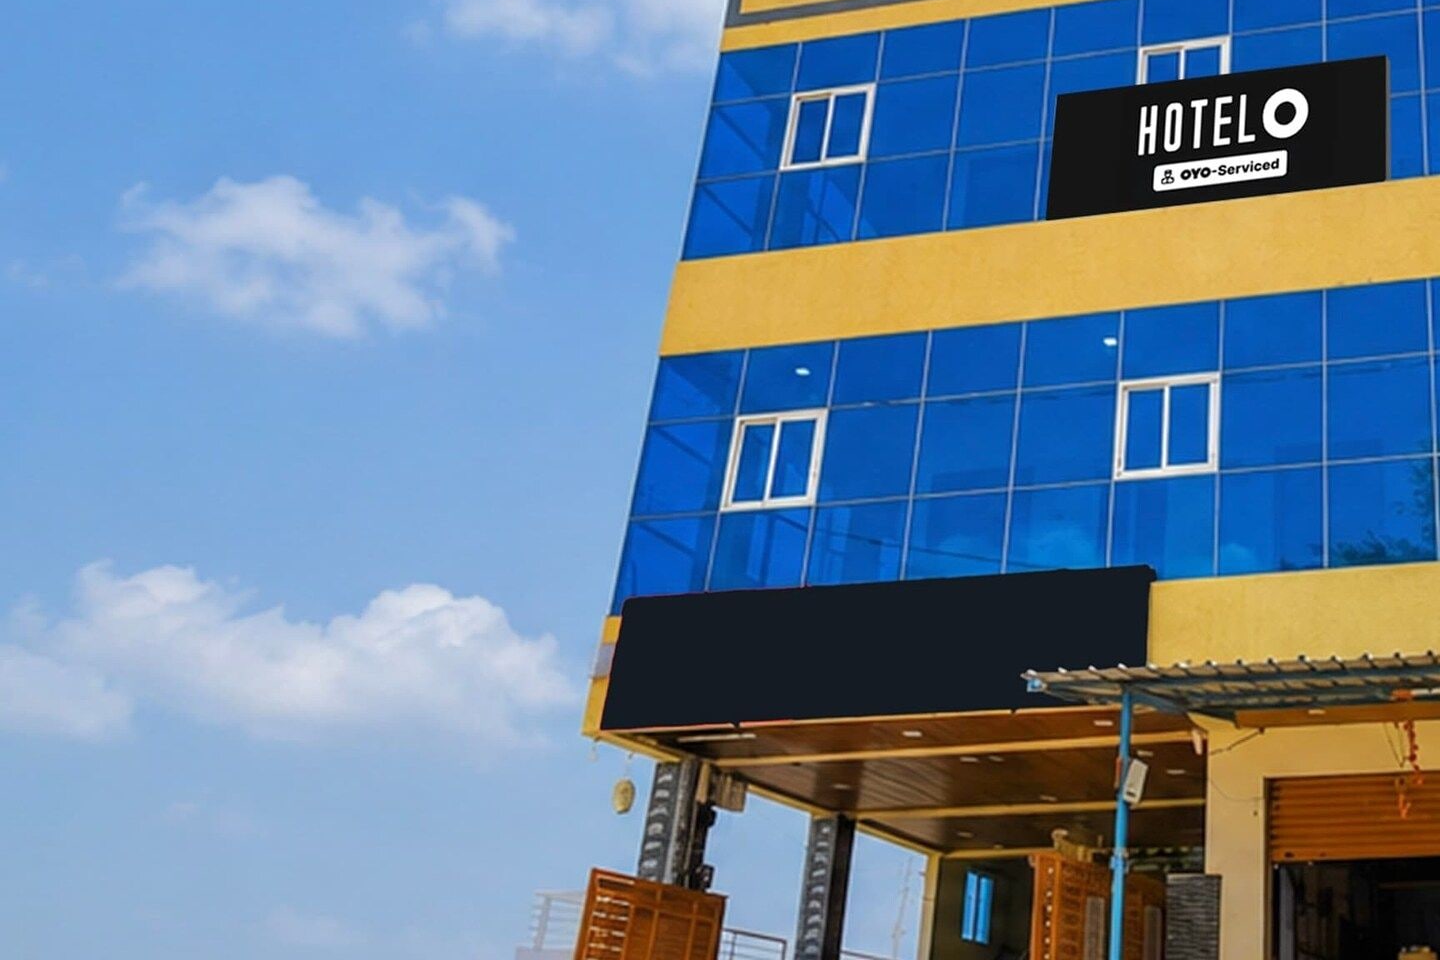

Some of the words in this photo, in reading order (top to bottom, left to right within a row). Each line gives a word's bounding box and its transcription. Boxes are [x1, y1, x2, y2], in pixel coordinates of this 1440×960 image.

[1137, 94, 1256, 156] HOTEL
[1262, 88, 1309, 139] O
[1180, 158, 1280, 181] OYO-Serviced
